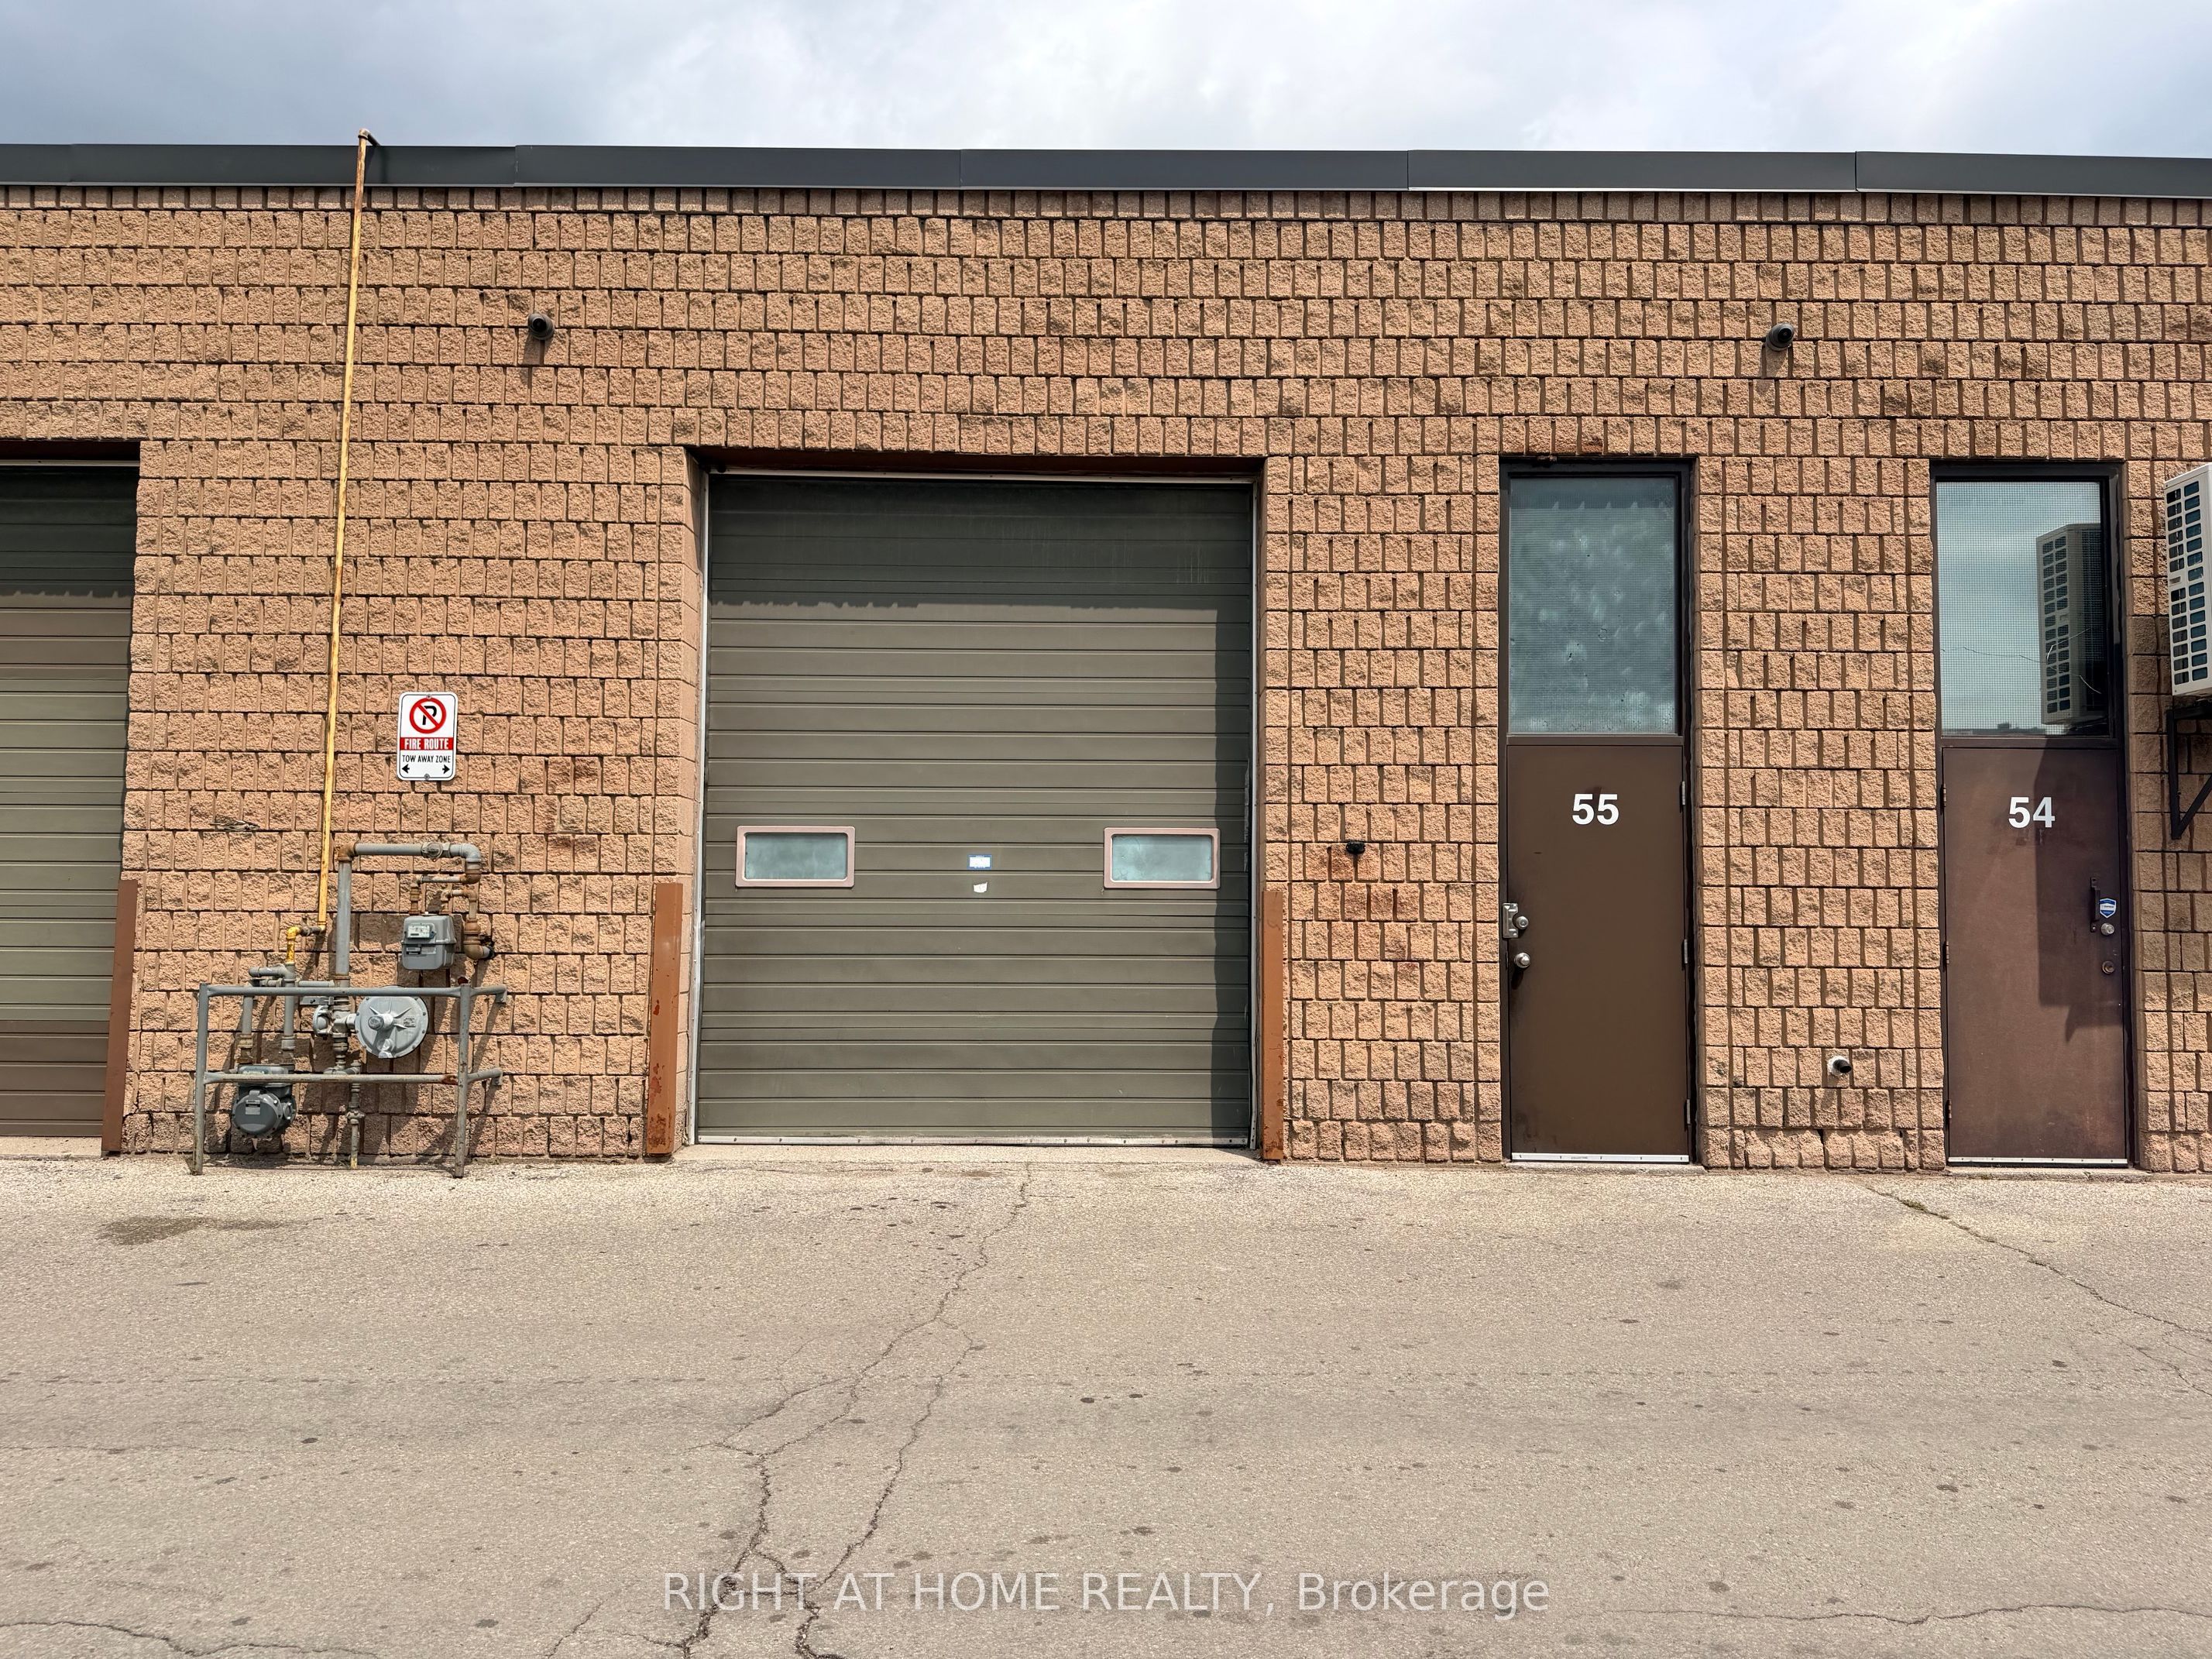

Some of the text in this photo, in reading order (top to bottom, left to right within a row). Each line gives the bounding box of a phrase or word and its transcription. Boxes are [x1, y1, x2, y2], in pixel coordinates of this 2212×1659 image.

[404, 738, 448, 750] FIRE ROUTE
[1571, 793, 1620, 825] 55
[2008, 796, 2056, 828] 54
